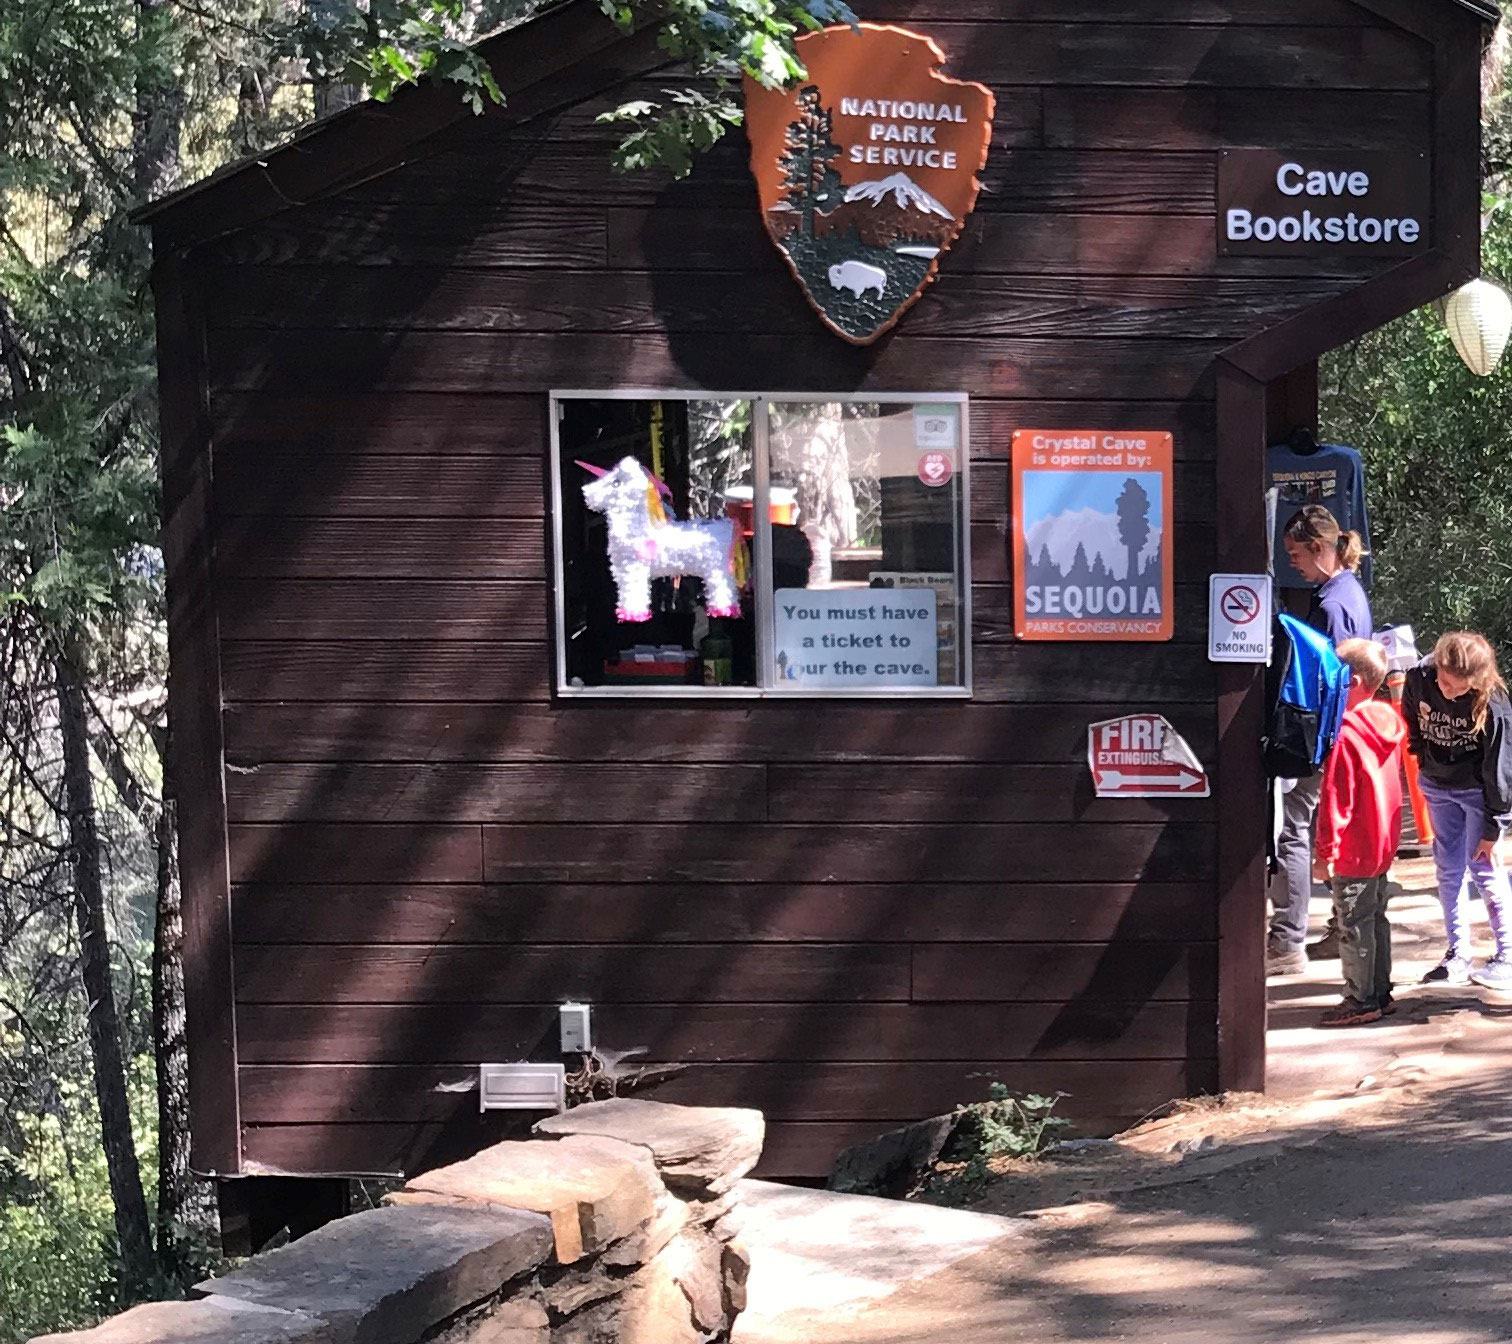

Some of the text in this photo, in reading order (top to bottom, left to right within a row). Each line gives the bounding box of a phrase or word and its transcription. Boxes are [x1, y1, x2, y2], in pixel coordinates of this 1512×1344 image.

[840, 97, 968, 123] NATIONAL
[869, 122, 937, 145] PARK
[849, 144, 958, 170] SERVICE
[1276, 162, 1370, 196] Cave
[1226, 208, 1421, 243] Bookstore
[1032, 435, 1147, 452] Crystal Cave
[1032, 452, 1152, 468] is operated by:
[1025, 584, 1162, 618] SEQUOIA
[783, 605, 929, 621] You must have
[1025, 622, 1163, 634] PARKS CONSERVANCY
[1232, 631, 1247, 641] NO
[802, 632, 912, 649] a ticket to
[1215, 643, 1264, 653] SMOKING
[833, 660, 871, 675] the
[874, 663, 930, 676] cave.
[1097, 751, 1175, 766] EXTINGUIS
